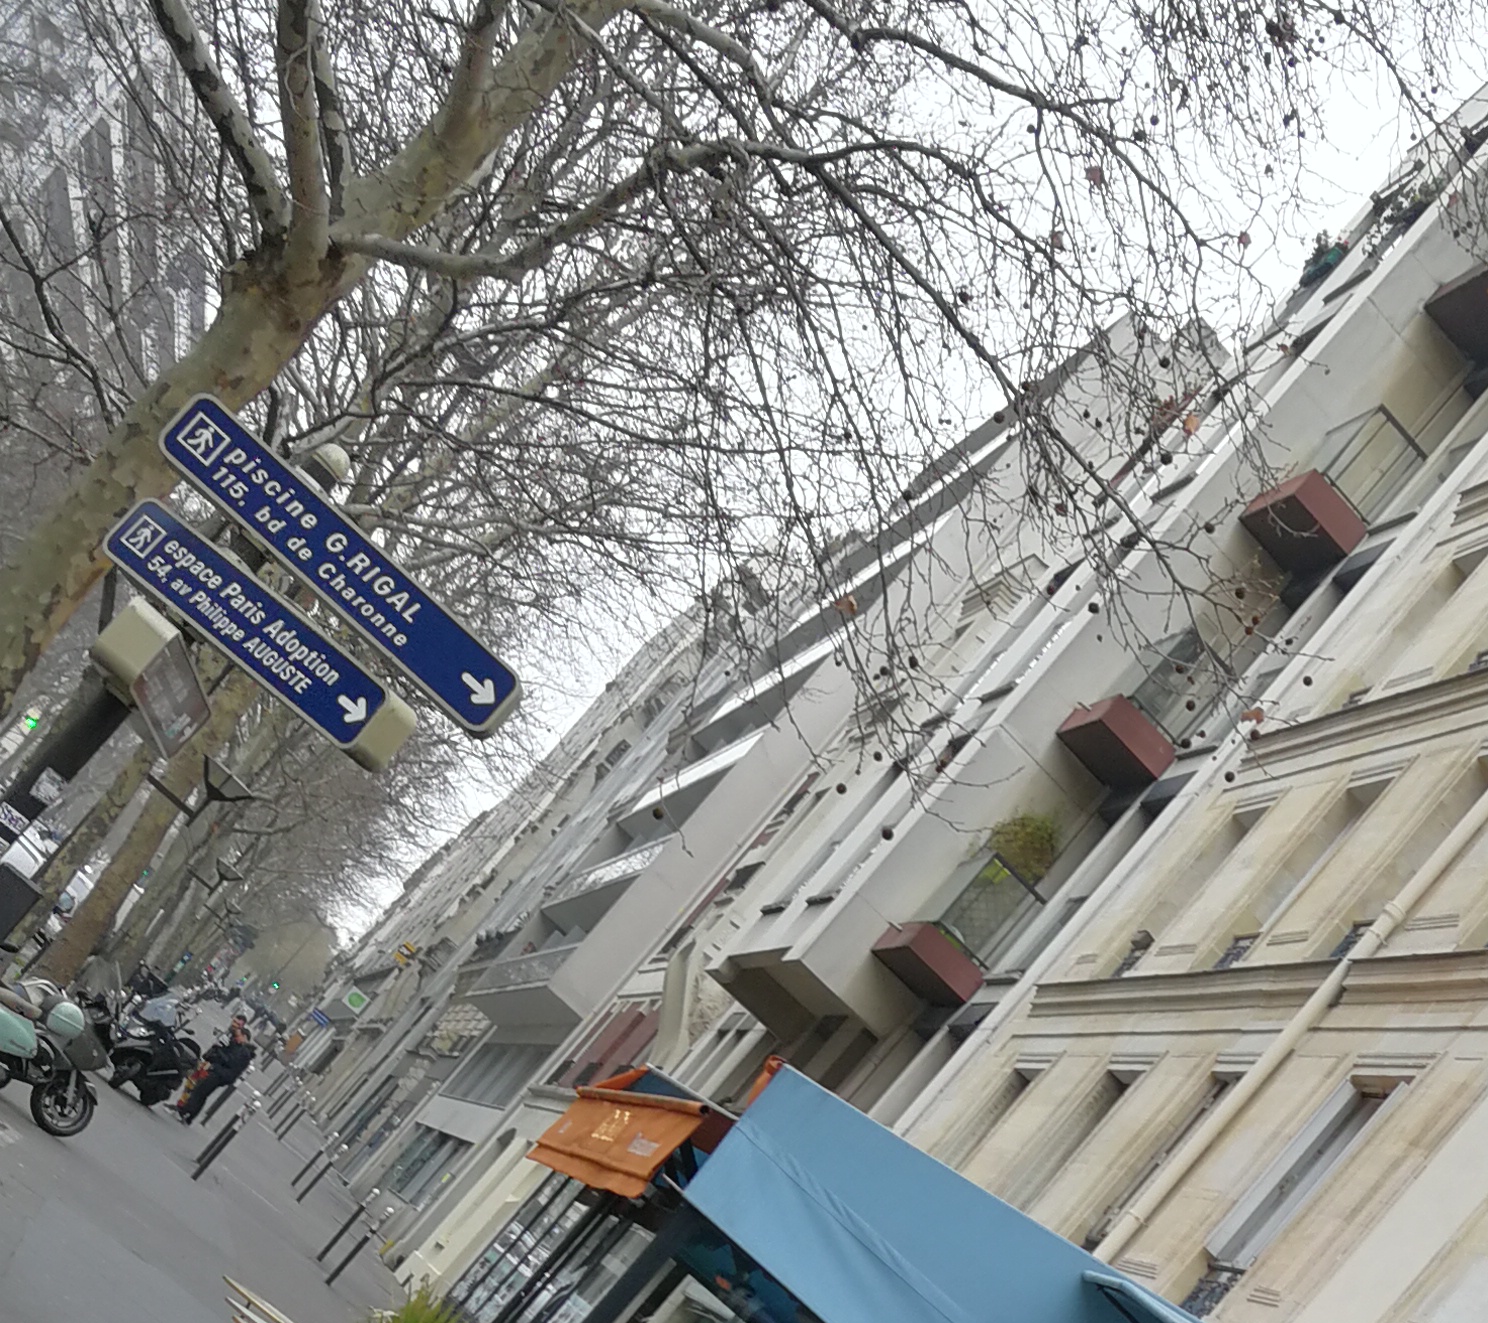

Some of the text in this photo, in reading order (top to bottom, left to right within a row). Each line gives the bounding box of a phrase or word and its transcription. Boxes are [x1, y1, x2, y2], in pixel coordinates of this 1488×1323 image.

[224, 448, 424, 624] piscine G.RIGAL
[254, 505, 282, 534] bd
[287, 535, 314, 561] de
[317, 562, 408, 647] Charonne
[163, 539, 340, 687] espace Paris Adoption
[170, 578, 193, 601] av
[192, 591, 244, 645] Philippe
[242, 635, 314, 695] AUGUSTE
